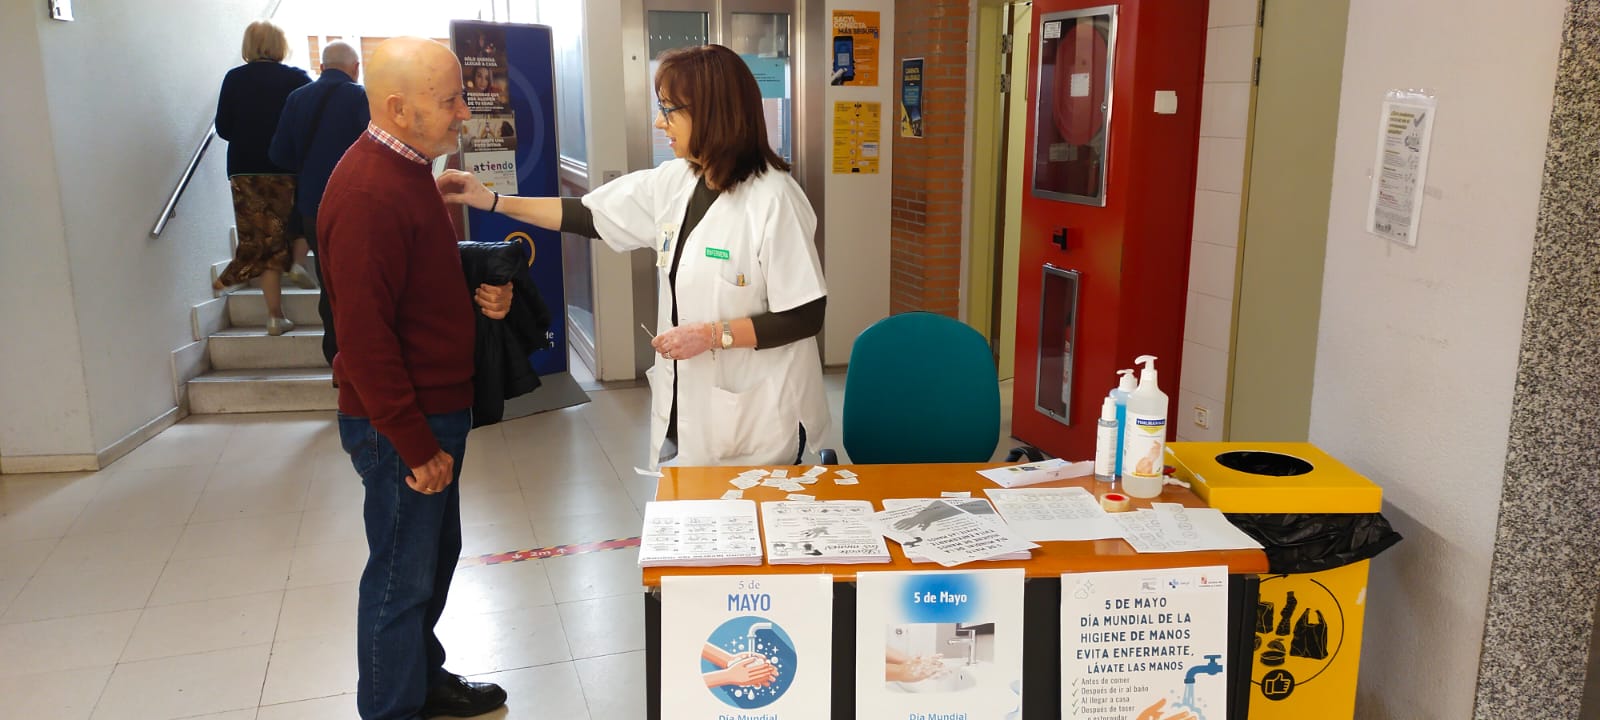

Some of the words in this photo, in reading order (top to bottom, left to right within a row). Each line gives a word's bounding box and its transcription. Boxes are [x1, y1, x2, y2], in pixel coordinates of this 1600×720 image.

[474, 161, 514, 172] atiendo
[739, 581, 744, 589] 5
[748, 580, 760, 590] de
[728, 594, 771, 611] MAYO
[914, 592, 920, 603] 5
[924, 592, 936, 603] de
[940, 592, 967, 606] Mayo
[1105, 600, 1111, 610] 5
[1115, 599, 1130, 609] DE
[1134, 597, 1167, 609] MAYO
[1080, 614, 1099, 627] DÍA
[1104, 613, 1153, 626] MUNDIAL
[1158, 613, 1173, 623] DE
[1177, 613, 1191, 623] LA
[1081, 631, 1126, 643] HIGIENE
[1130, 630, 1145, 641] DE
[1149, 629, 1191, 641] MANOS
[1077, 648, 1109, 660] EVITA
[1113, 645, 1194, 658] ENFERMARTE,
[1088, 662, 1124, 674] LÁVATE
[1127, 662, 1146, 672] LAS
[1149, 661, 1184, 672] MANOS
[1090, 697, 1108, 705] llegar
[928, 712, 967, 720] Mundial
